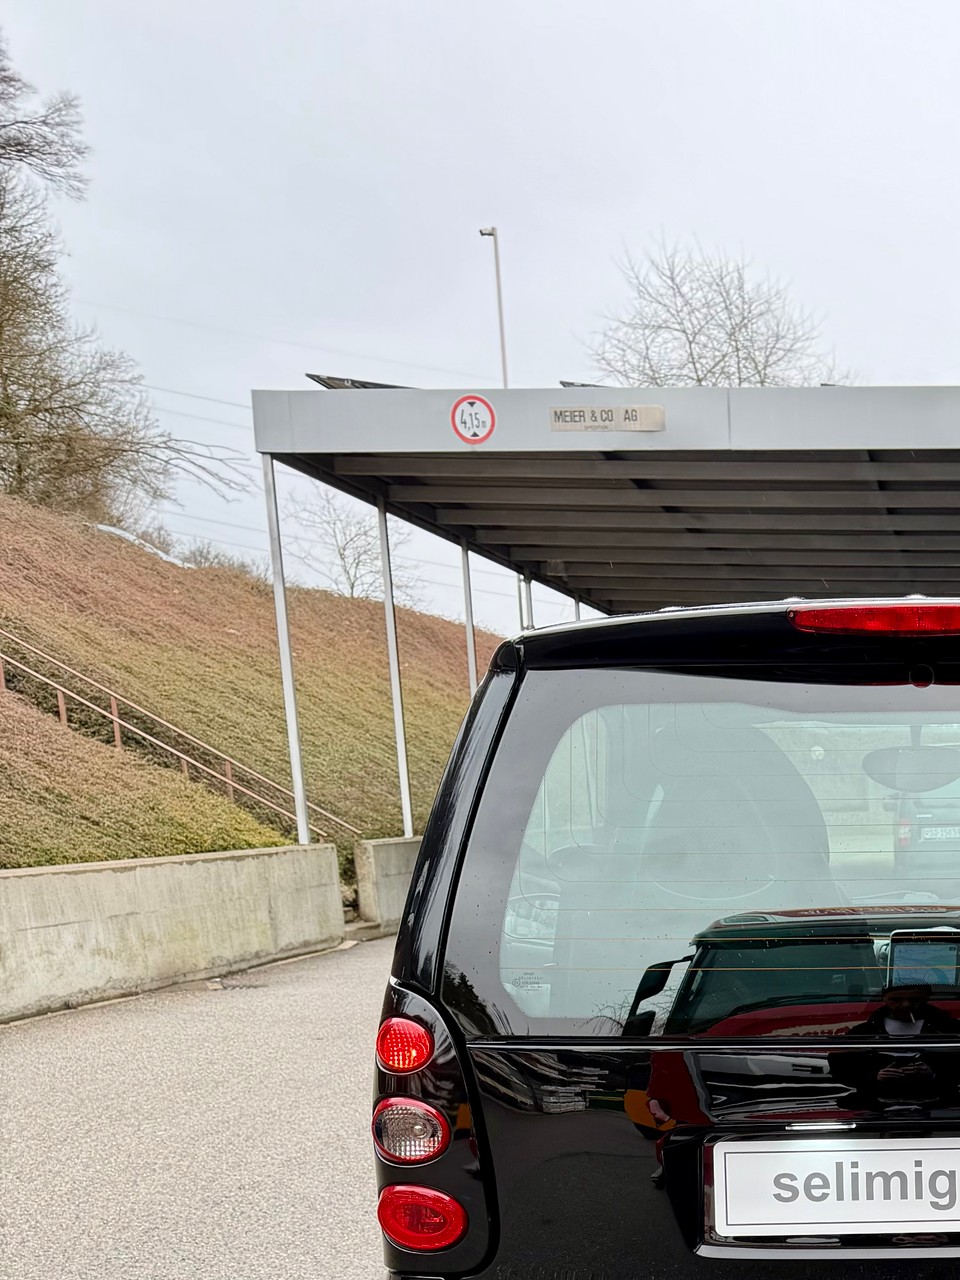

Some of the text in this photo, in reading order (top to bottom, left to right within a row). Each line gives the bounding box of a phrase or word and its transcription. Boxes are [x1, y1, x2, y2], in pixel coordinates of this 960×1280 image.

[554, 408, 638, 423] MEIER & CO AG
